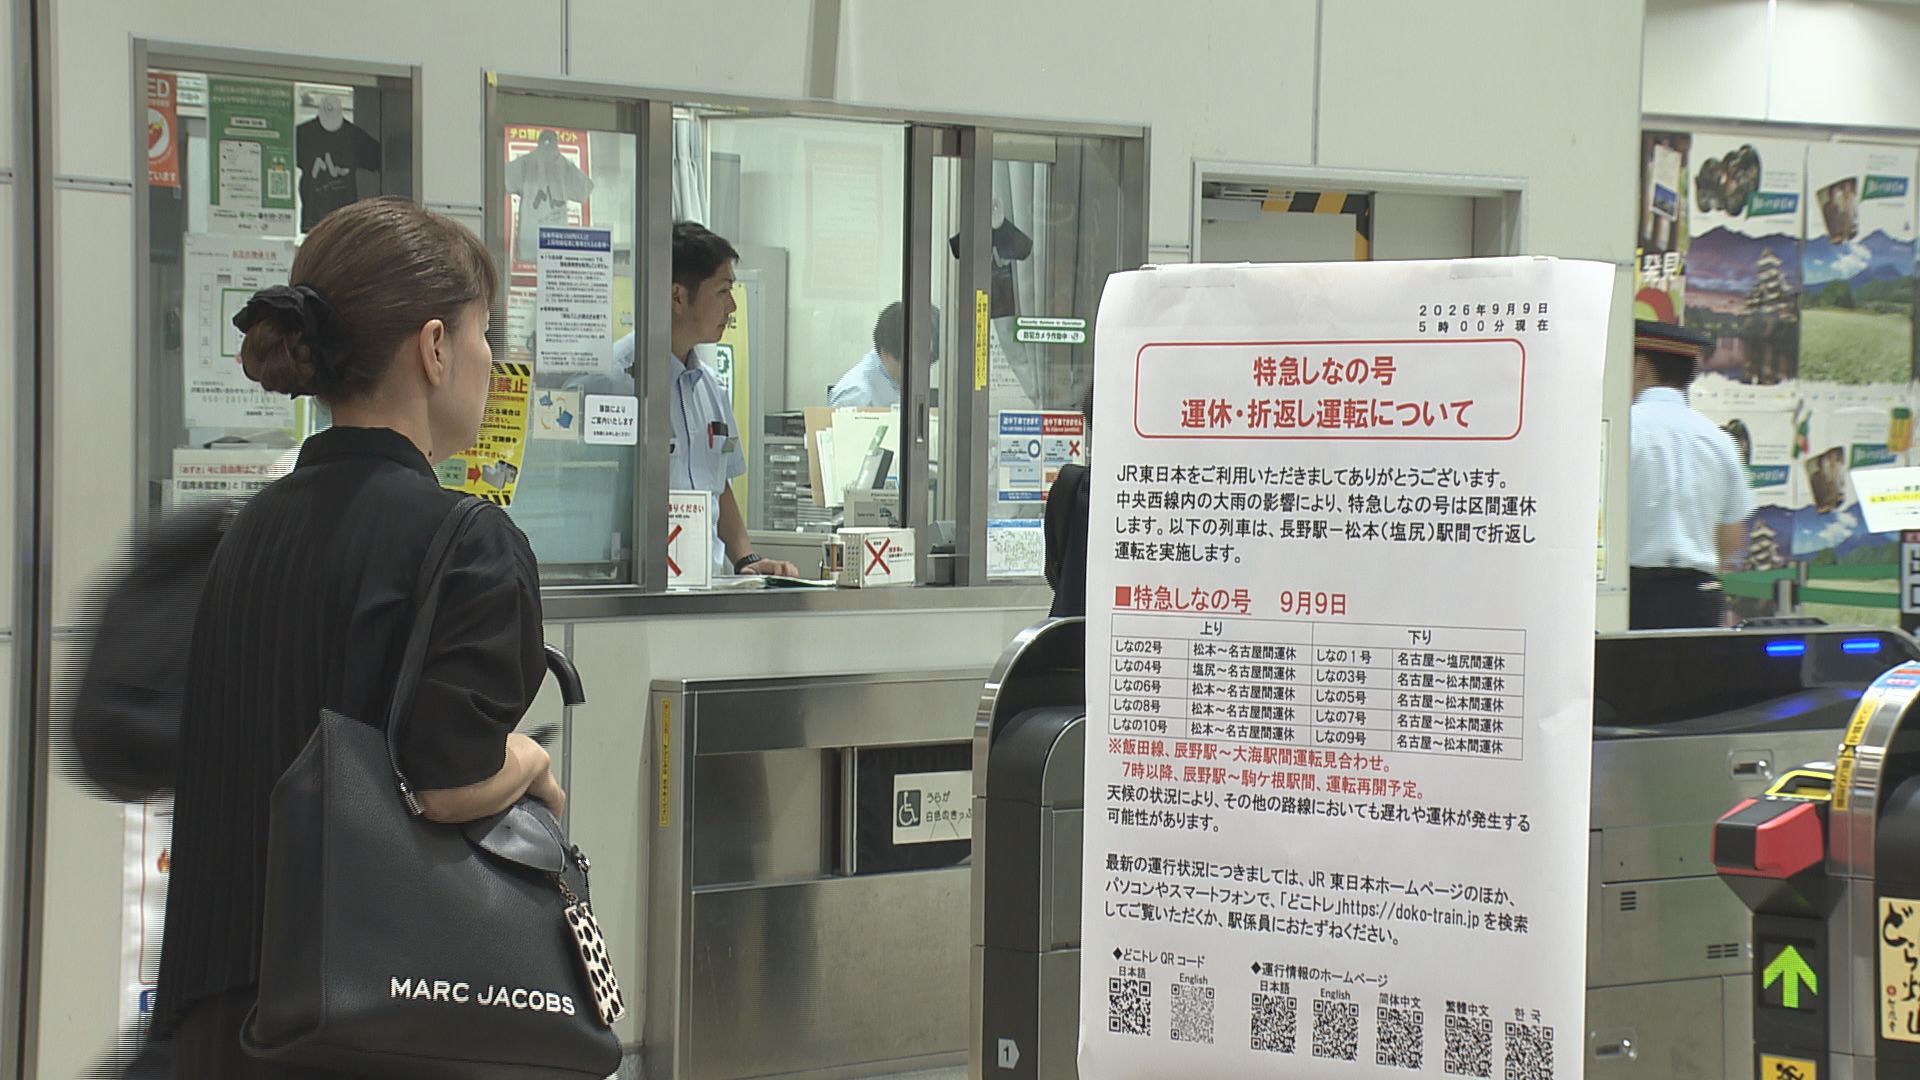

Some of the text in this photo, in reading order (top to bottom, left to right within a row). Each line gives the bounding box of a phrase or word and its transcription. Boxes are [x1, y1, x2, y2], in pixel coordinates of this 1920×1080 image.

[1418, 302, 1550, 318] 2026年9月9日
[1418, 318, 1550, 333] 5時00分現在
[1253, 356, 1397, 387] 特急しなの号
[1181, 398, 1475, 431] 運休・折返し運転について
[1116, 464, 1507, 489] JR東日本をご利用いただきましてありがとうございます。
[1116, 490, 1537, 517] 中央西線内の大雨の影響により、特急しなの号は区間運休
[1115, 541, 1242, 564] 運転を実施します。
[1133, 584, 1347, 616] 特急しなの号 9月9日
[1200, 621, 1224, 637] 上り
[1408, 629, 1432, 645] 下り
[1115, 640, 1162, 655] しなの2号
[1115, 659, 1162, 674] しなの4号
[1316, 669, 1367, 685] しなの3号
[1114, 679, 1161, 694] しなの6号
[1316, 689, 1367, 705] しなの5号
[1113, 698, 1161, 713] しなの8号
[1316, 709, 1366, 726] しなの7号
[1113, 718, 1168, 733] しなの10号
[1316, 730, 1366, 746] しなの9号
[1106, 784, 1530, 833] 天候の状況により、その他の路線においても遅れや運休が発生する
[1107, 807, 1219, 833] 可能性があります。
[1104, 900, 1399, 946] してご覧いただくか、駅係員におたずねください。
[1118, 966, 1147, 979] 日本語
[1179, 972, 1209, 985] English
[1261, 962, 1389, 988] 運行情報のホームページ
[390, 977, 576, 1016] MARC JACOBS
[1259, 980, 1291, 995] 日本語
[1319, 987, 1352, 1001] English
[1003, 1045, 1010, 1062] 1
